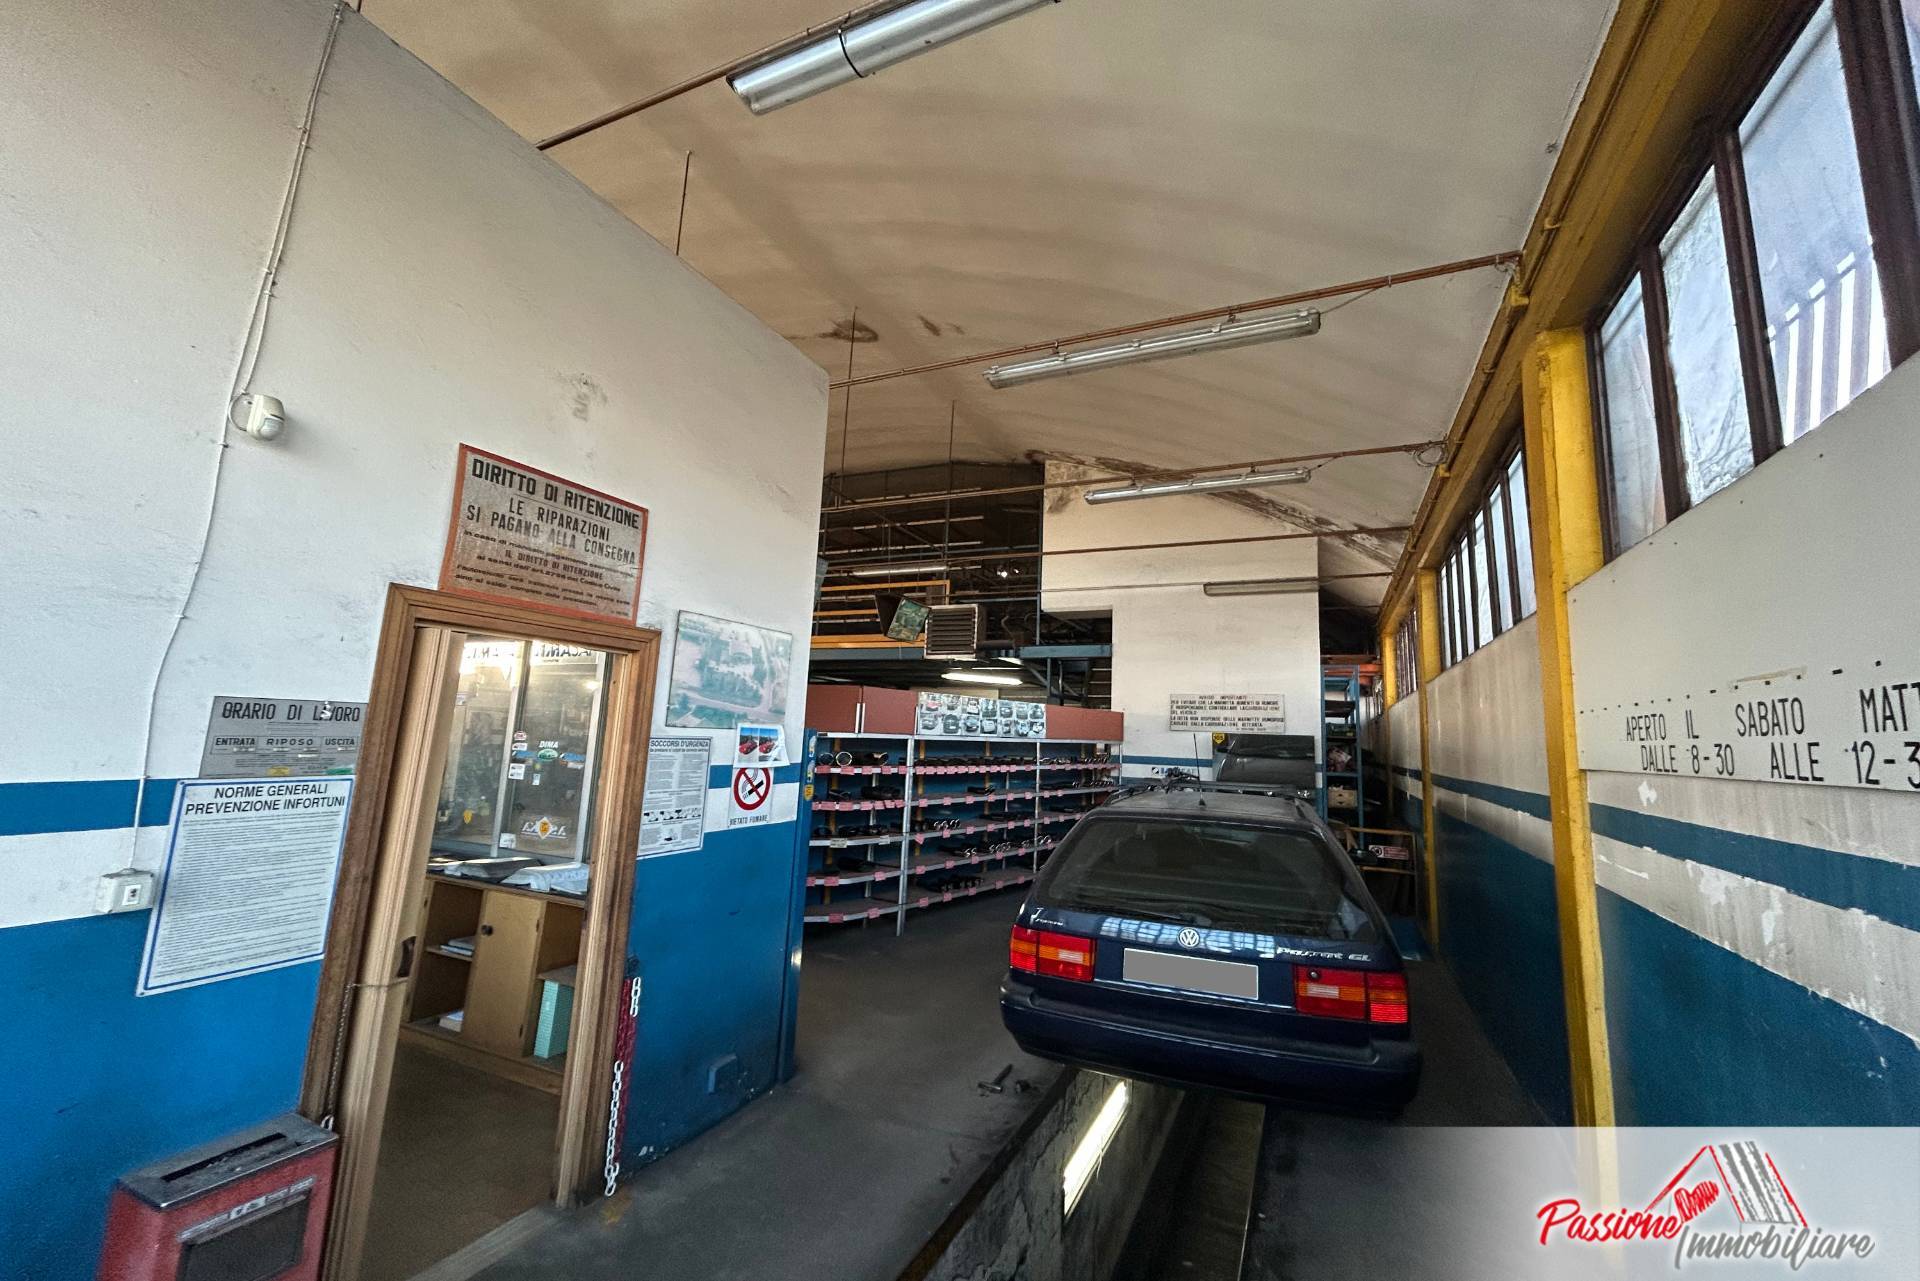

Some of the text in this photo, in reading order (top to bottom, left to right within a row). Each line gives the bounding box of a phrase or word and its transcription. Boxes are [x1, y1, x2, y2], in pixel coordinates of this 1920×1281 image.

[471, 458, 641, 530] DIRITTO DI RITENZIONE
[508, 497, 611, 542] LE RIPARAZIONI
[466, 504, 636, 565] SI PAGANO ALLA CONSEGNA
[517, 552, 548, 567] DIRITTO
[562, 563, 603, 580] RITENZIONE
[221, 701, 277, 720] ORARIO
[286, 704, 303, 721] DI
[1625, 713, 1667, 742] APERTO
[1685, 710, 1700, 739] IL
[1735, 697, 1805, 737] SABATO
[215, 737, 355, 746] ENTRATA RIPOSO USCITA
[538, 740, 559, 748] DIMA
[650, 740, 680, 748] SOCCORSI
[1640, 744, 1679, 773] DALLE
[1770, 741, 1825, 782] ALLE
[214, 783, 328, 800] NORME GENERALI
[185, 796, 345, 816] PREVENZIONE INFORTUNI
